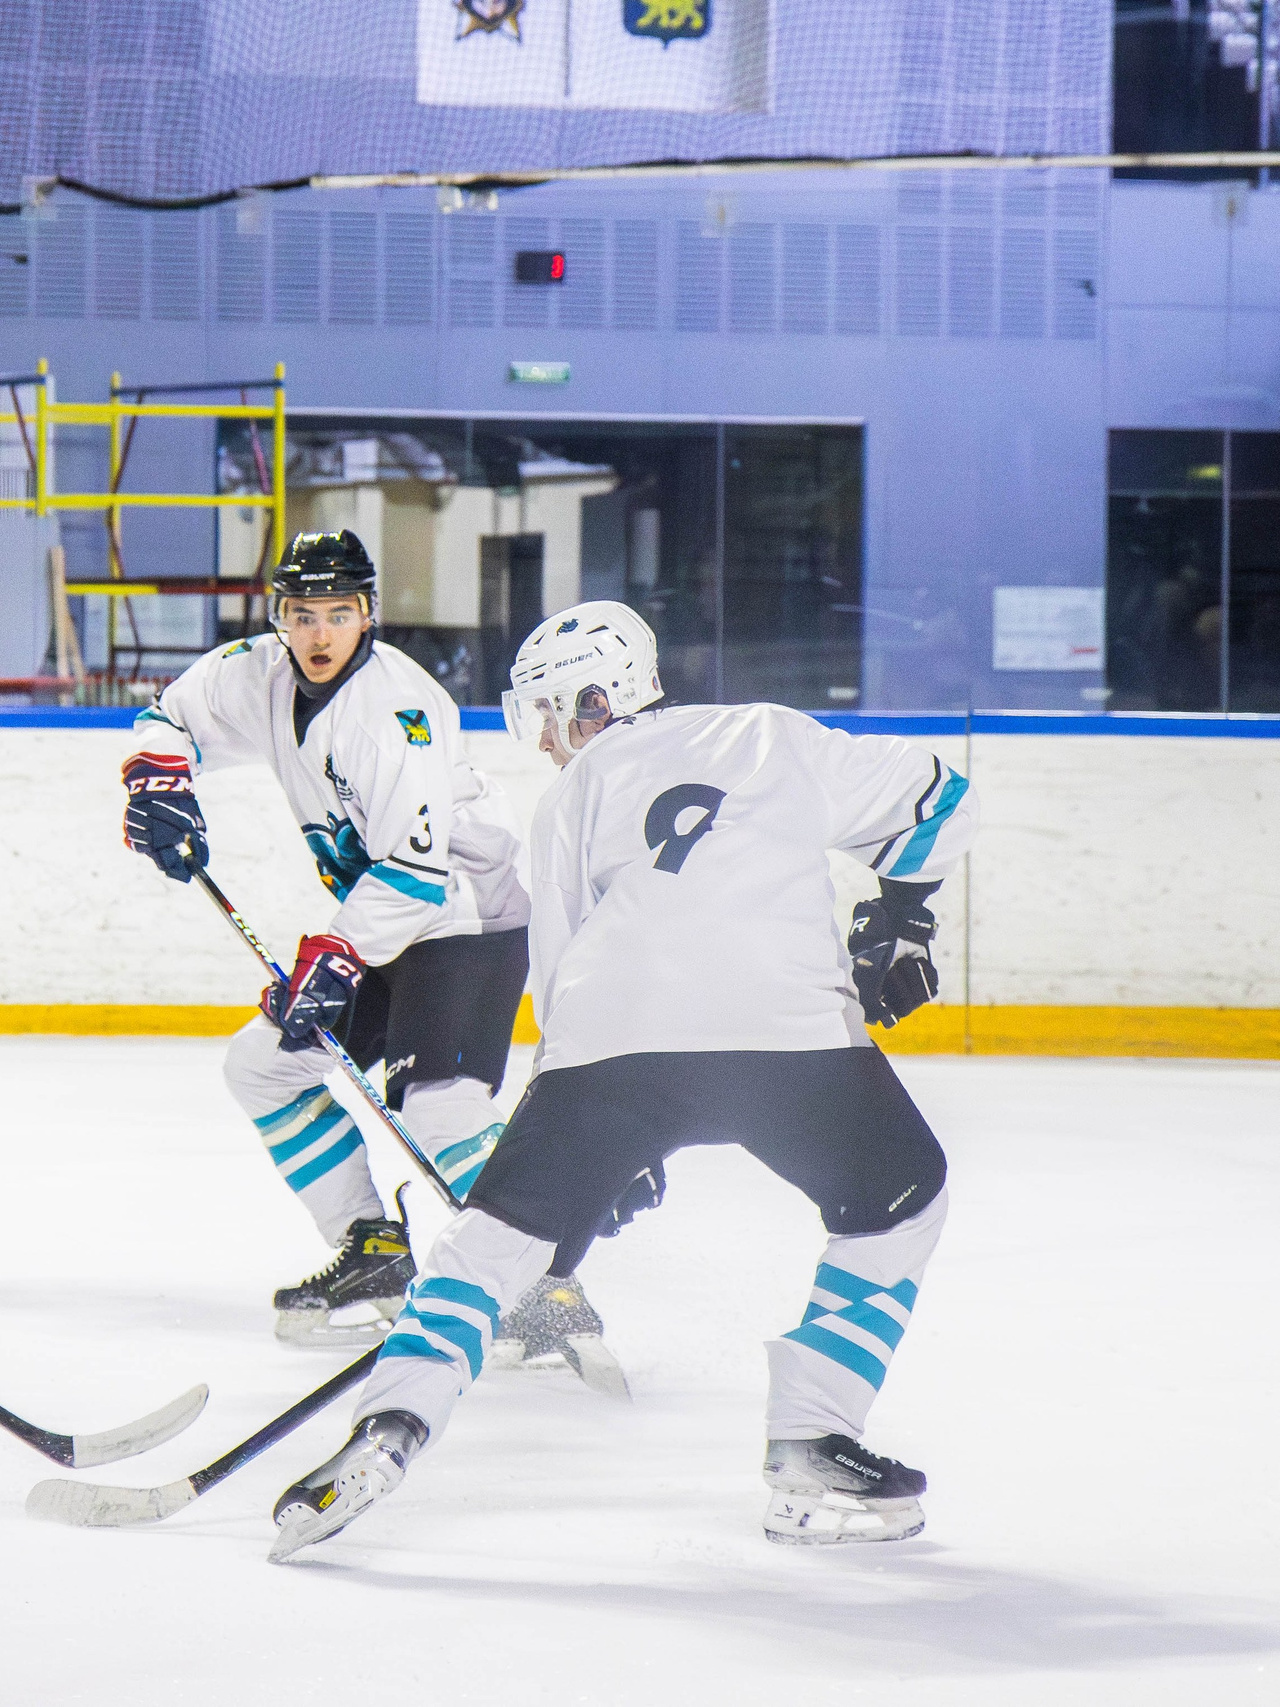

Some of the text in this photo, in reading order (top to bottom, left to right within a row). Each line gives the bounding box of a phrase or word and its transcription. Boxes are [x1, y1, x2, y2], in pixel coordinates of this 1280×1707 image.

[554, 652, 595, 669] BAUER
[409, 803, 432, 854] 3
[230, 911, 277, 964] CCM
[385, 1054, 416, 1081] CM
[835, 1454, 883, 1480] BAUER
